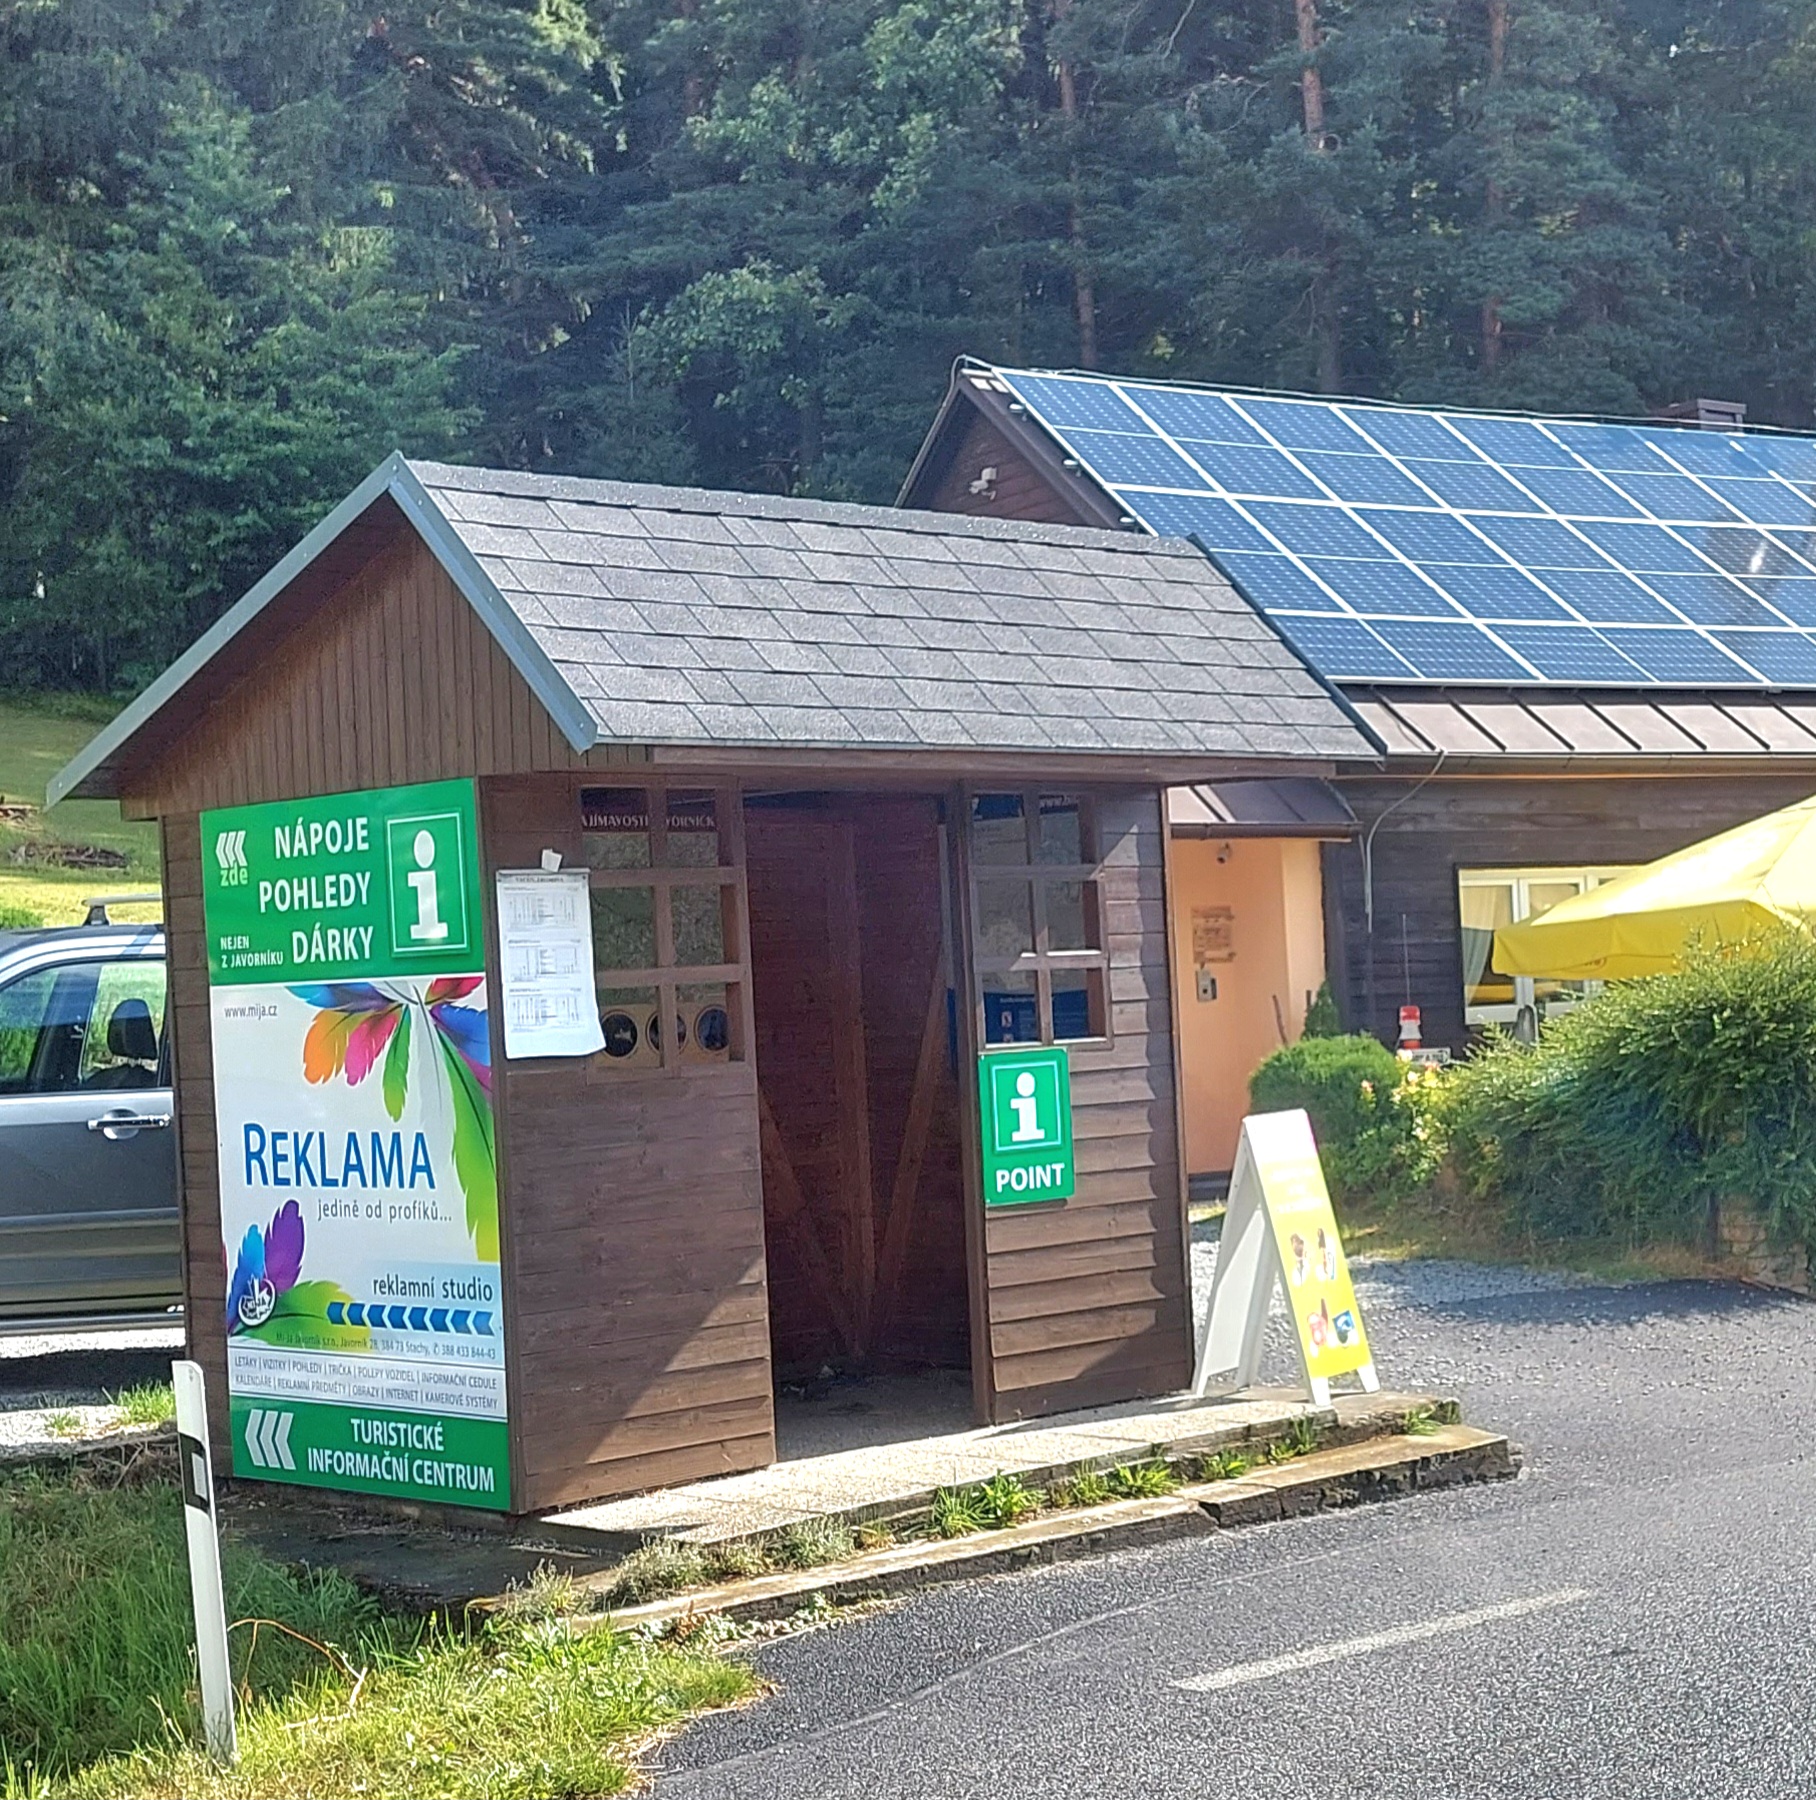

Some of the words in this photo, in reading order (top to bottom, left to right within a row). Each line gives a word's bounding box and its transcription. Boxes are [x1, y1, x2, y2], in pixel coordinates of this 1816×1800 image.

[274, 816, 369, 859] NÁPOJE
[220, 858, 248, 887] zde
[259, 871, 371, 913] POHLEDY
[220, 935, 250, 950] NEJEN
[292, 922, 373, 964] DÁRKY
[221, 956, 228, 968] Z
[230, 951, 283, 968] JAVORNÍKU
[224, 1003, 278, 1020] www.mija.cz
[243, 1123, 436, 1189] REKLAMA
[995, 1163, 1065, 1193] POINT
[318, 1199, 359, 1221] jedině
[366, 1200, 382, 1218] od
[373, 1273, 435, 1298] reklamní
[442, 1277, 493, 1301] studio
[292, 1360, 322, 1374] POHLEDY
[469, 1376, 497, 1390] CEDULE
[350, 1418, 444, 1452] TURISTICKÉ
[307, 1447, 409, 1483] INFORMAČNÍ
[412, 1459, 495, 1493] CENTRUM
